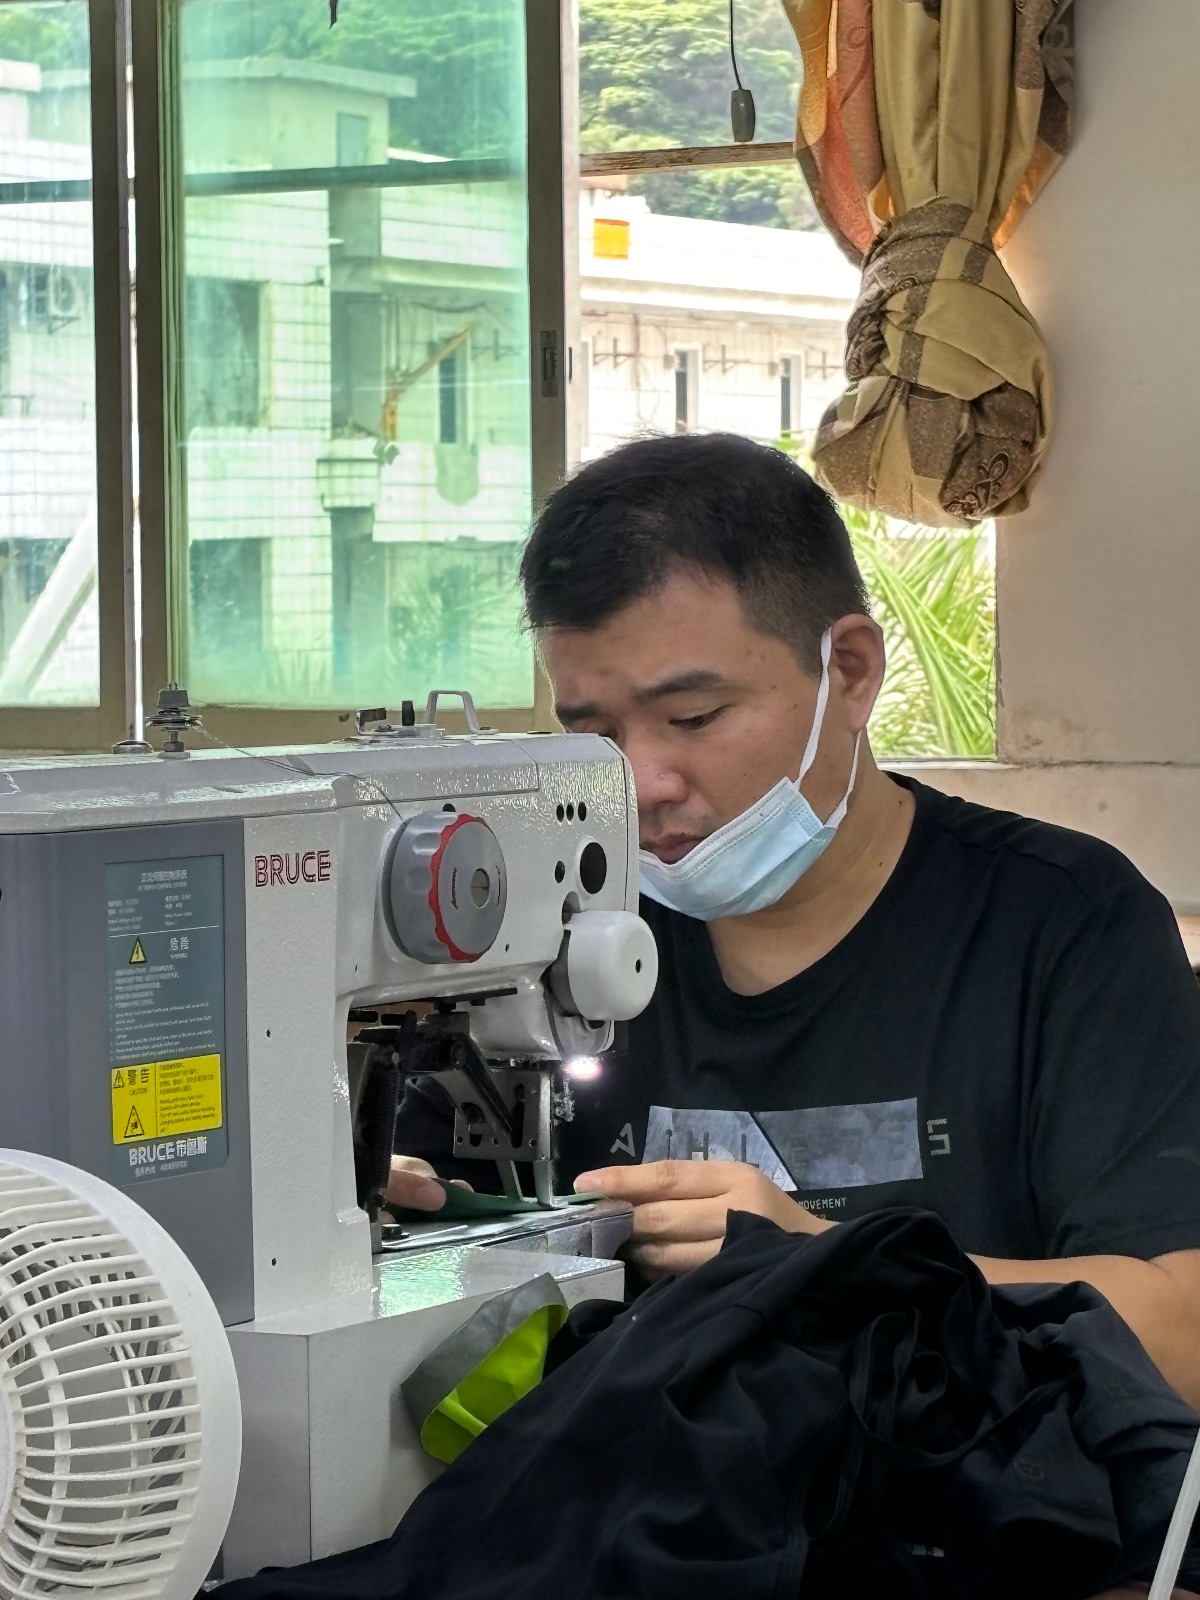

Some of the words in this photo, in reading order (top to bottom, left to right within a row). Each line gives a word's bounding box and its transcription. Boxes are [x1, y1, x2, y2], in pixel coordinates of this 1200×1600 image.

[255, 850, 332, 887] BRUCE
[128, 1141, 175, 1167] BRUCE
[798, 1197, 847, 1210] MOVEMENT
